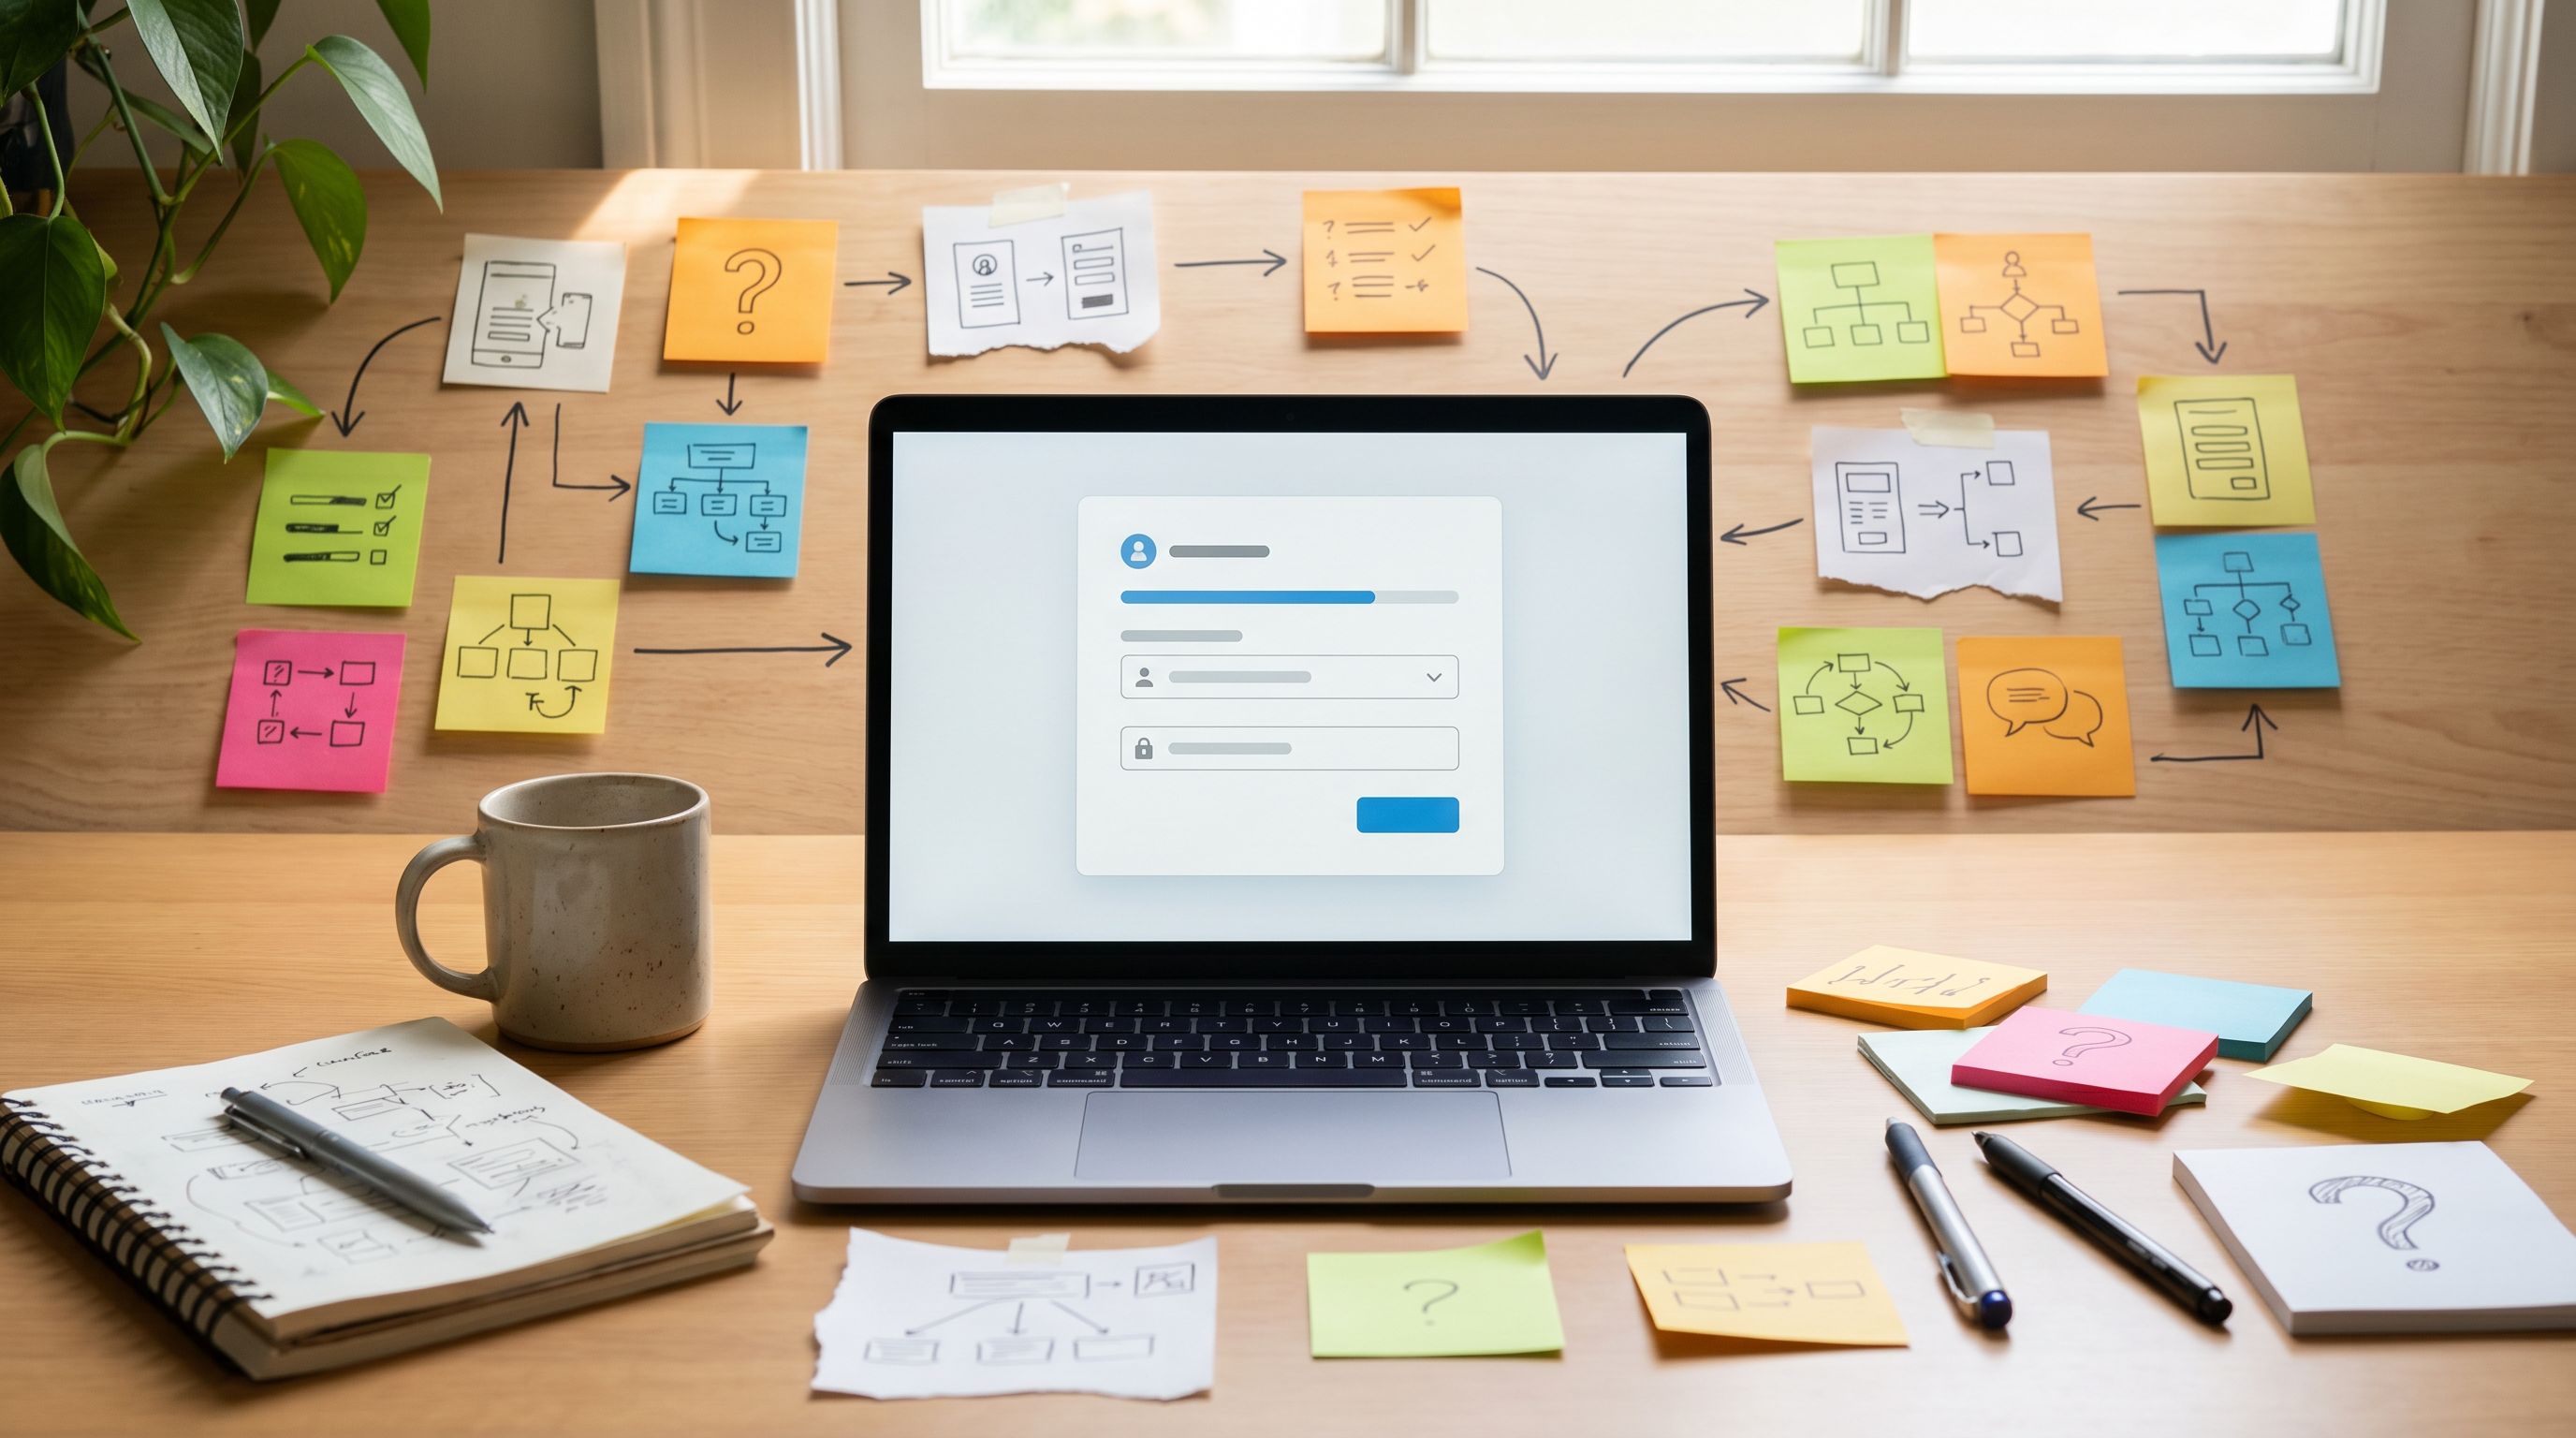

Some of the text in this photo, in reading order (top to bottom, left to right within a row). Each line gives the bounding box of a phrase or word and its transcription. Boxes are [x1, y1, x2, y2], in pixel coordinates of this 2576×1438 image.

[1323, 220, 1336, 240] ?
[724, 247, 782, 335] ?
[1327, 282, 1340, 301] ?
[2052, 1026, 2131, 1066] ?
[2308, 1175, 2438, 1271] ?
[1403, 1279, 1458, 1327] ?
